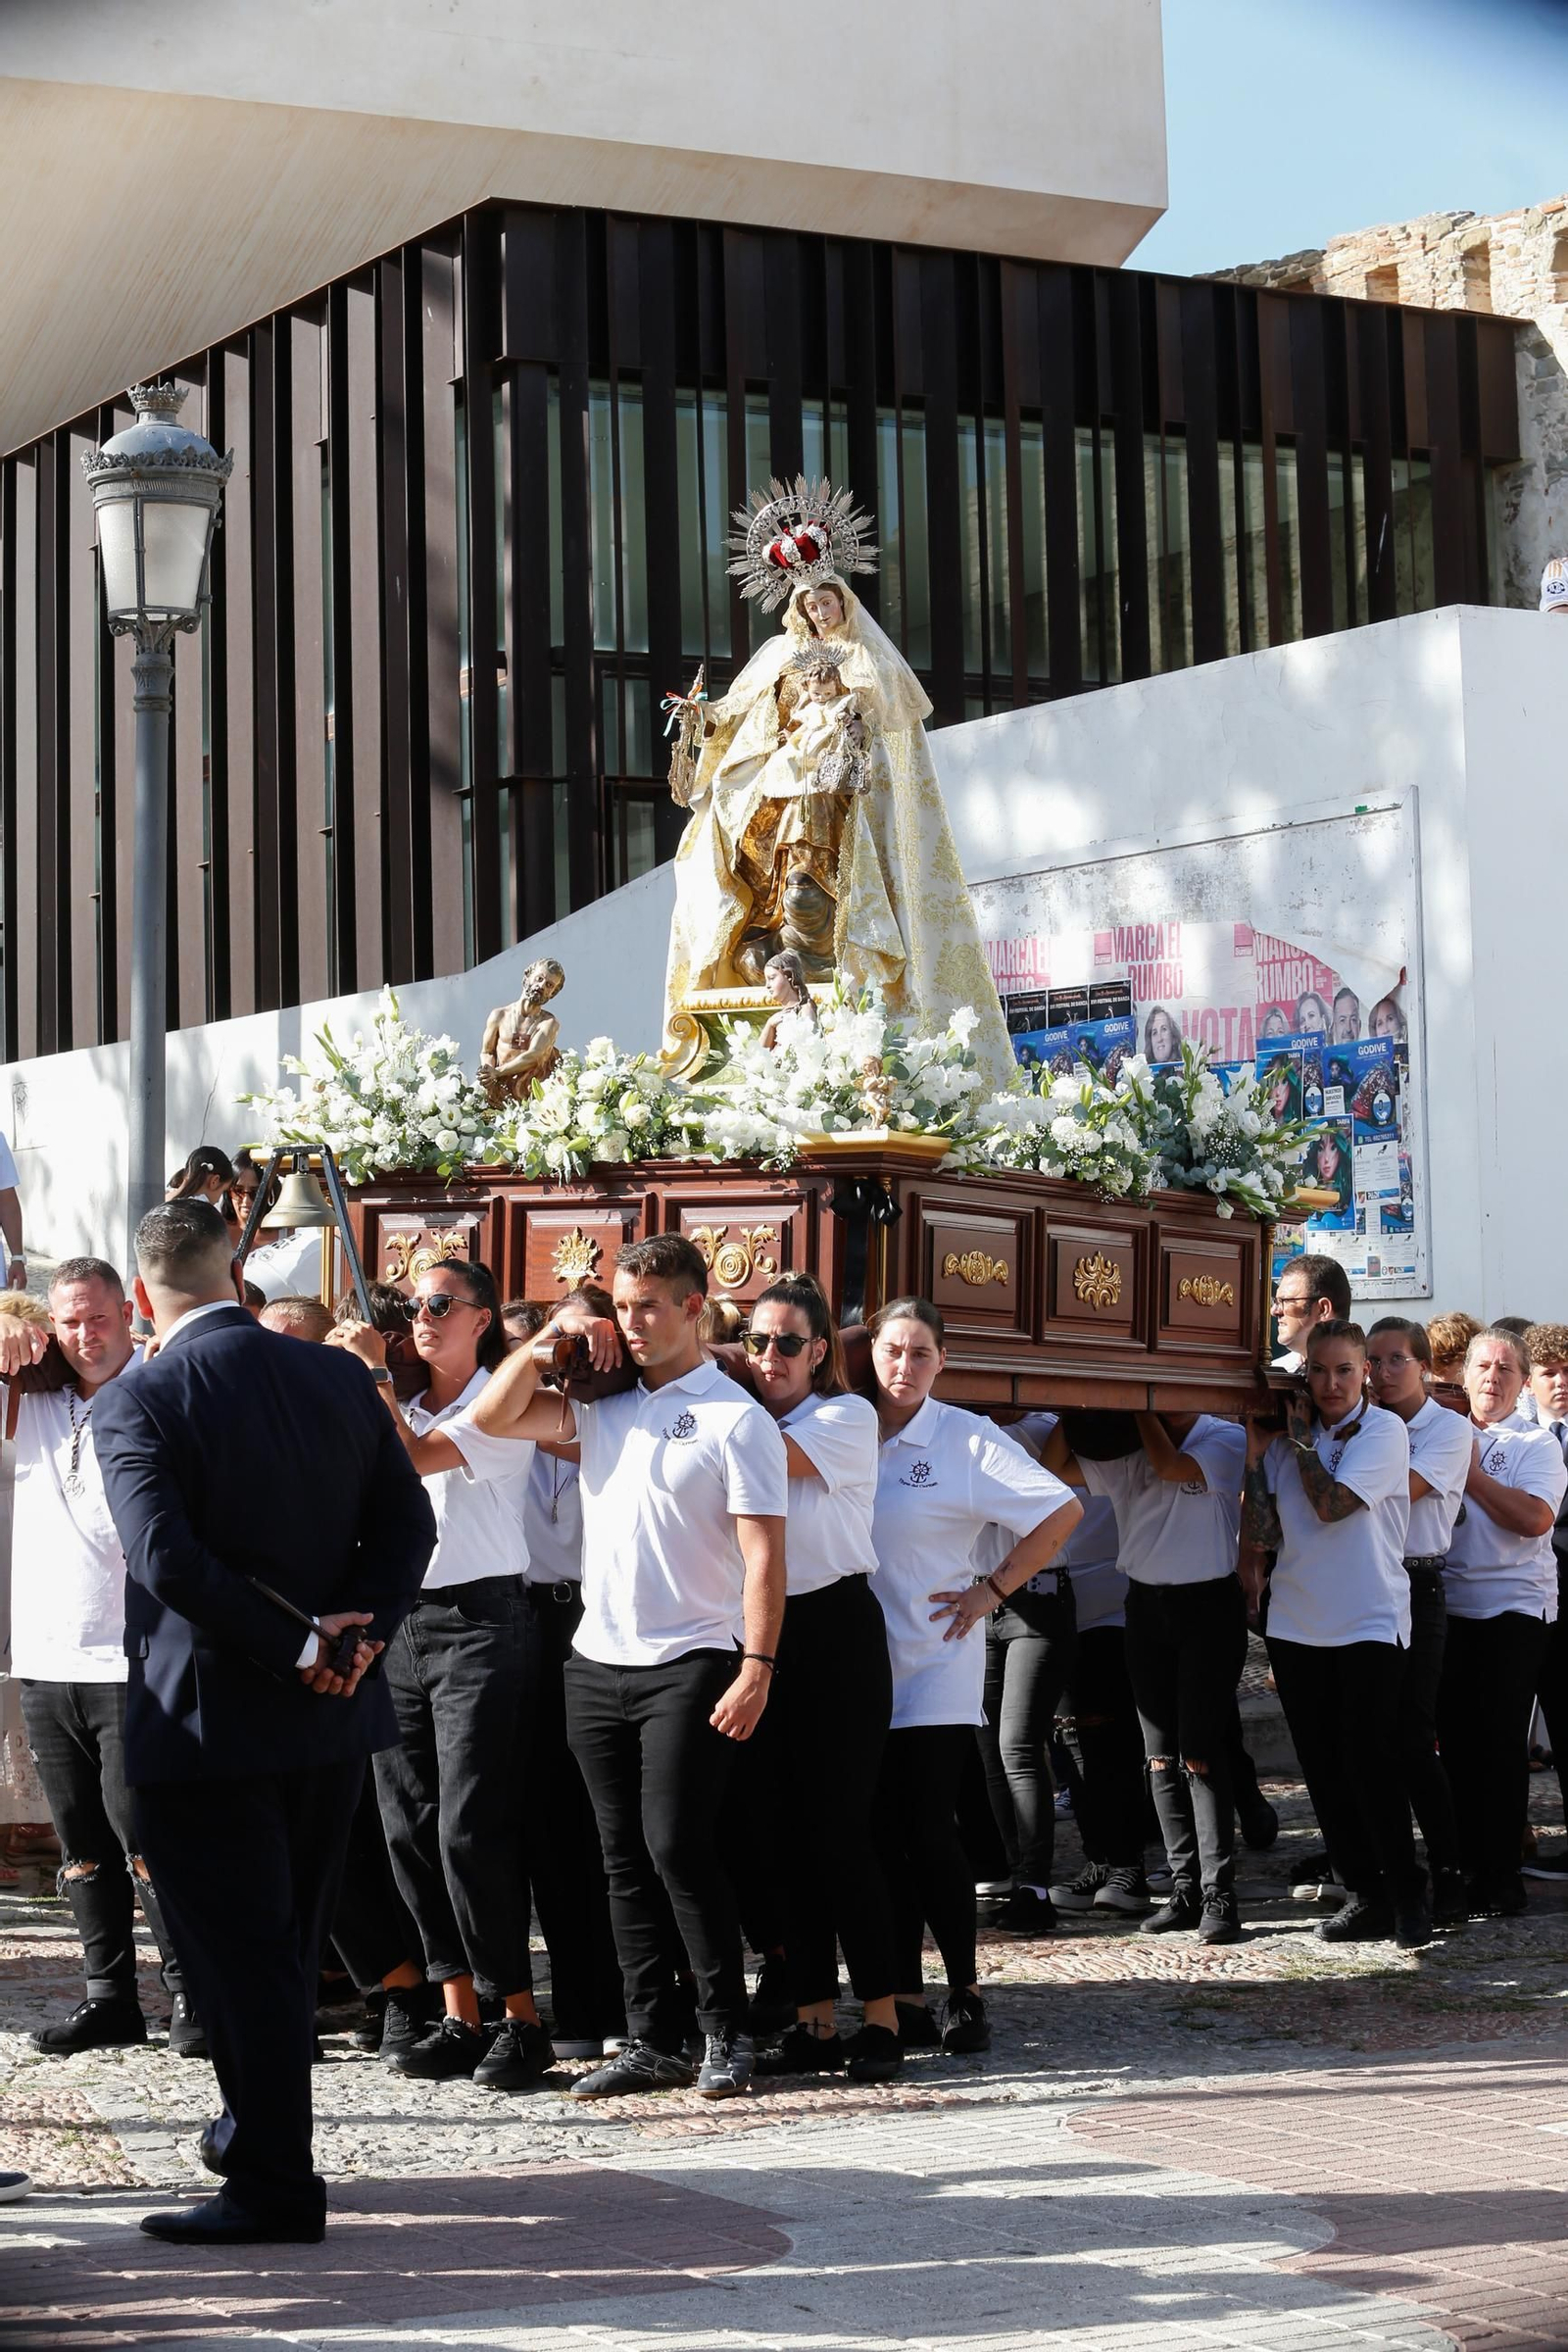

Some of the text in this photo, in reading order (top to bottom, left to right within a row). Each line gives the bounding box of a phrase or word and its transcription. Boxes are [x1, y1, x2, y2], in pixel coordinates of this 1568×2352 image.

[1253, 931, 1306, 962] MAR
[1128, 962, 1184, 1002] RUMBO
[1255, 958, 1313, 1004] RUMBO
[1104, 1021, 1130, 1034] GODIVE
[1045, 1030, 1068, 1043] GODIVE
[1291, 1037, 1318, 1049] GODIVE
[1358, 1043, 1387, 1055] GODIVE
